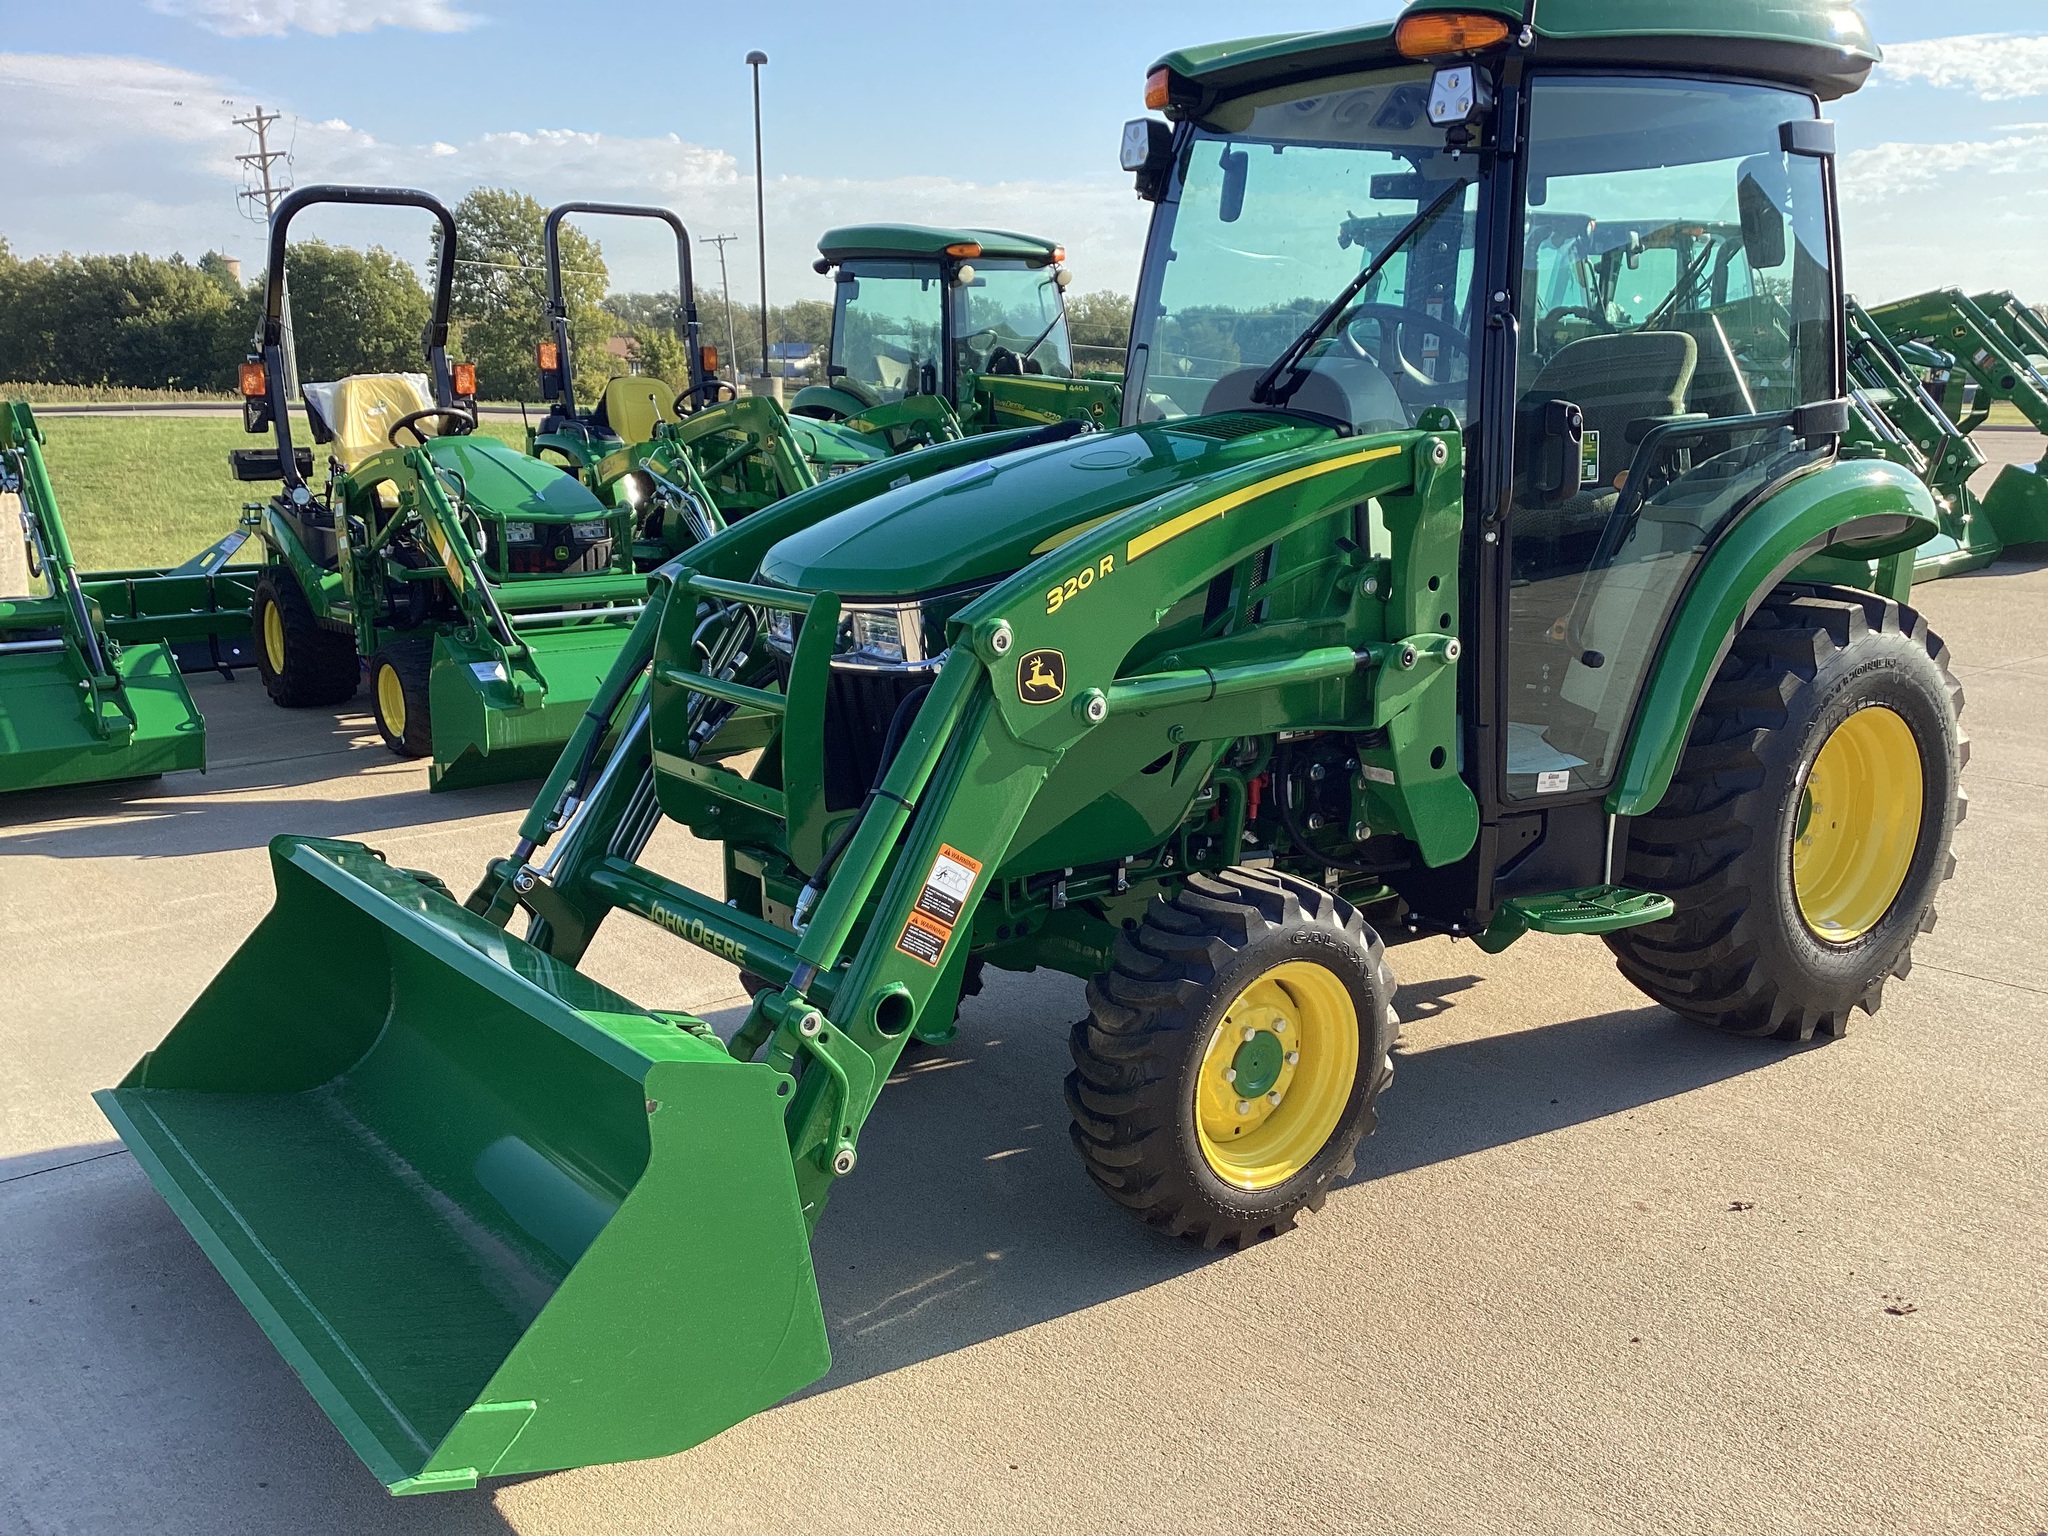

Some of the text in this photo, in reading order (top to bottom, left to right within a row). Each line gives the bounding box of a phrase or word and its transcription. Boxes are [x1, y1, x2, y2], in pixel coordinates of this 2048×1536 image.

[1046, 554, 1115, 615] 320 R
[951, 851, 977, 870] WARNING
[647, 900, 747, 965] JOHN DEERE
[920, 920, 946, 937] WARNING
[1291, 930, 1373, 980] GALAXY
